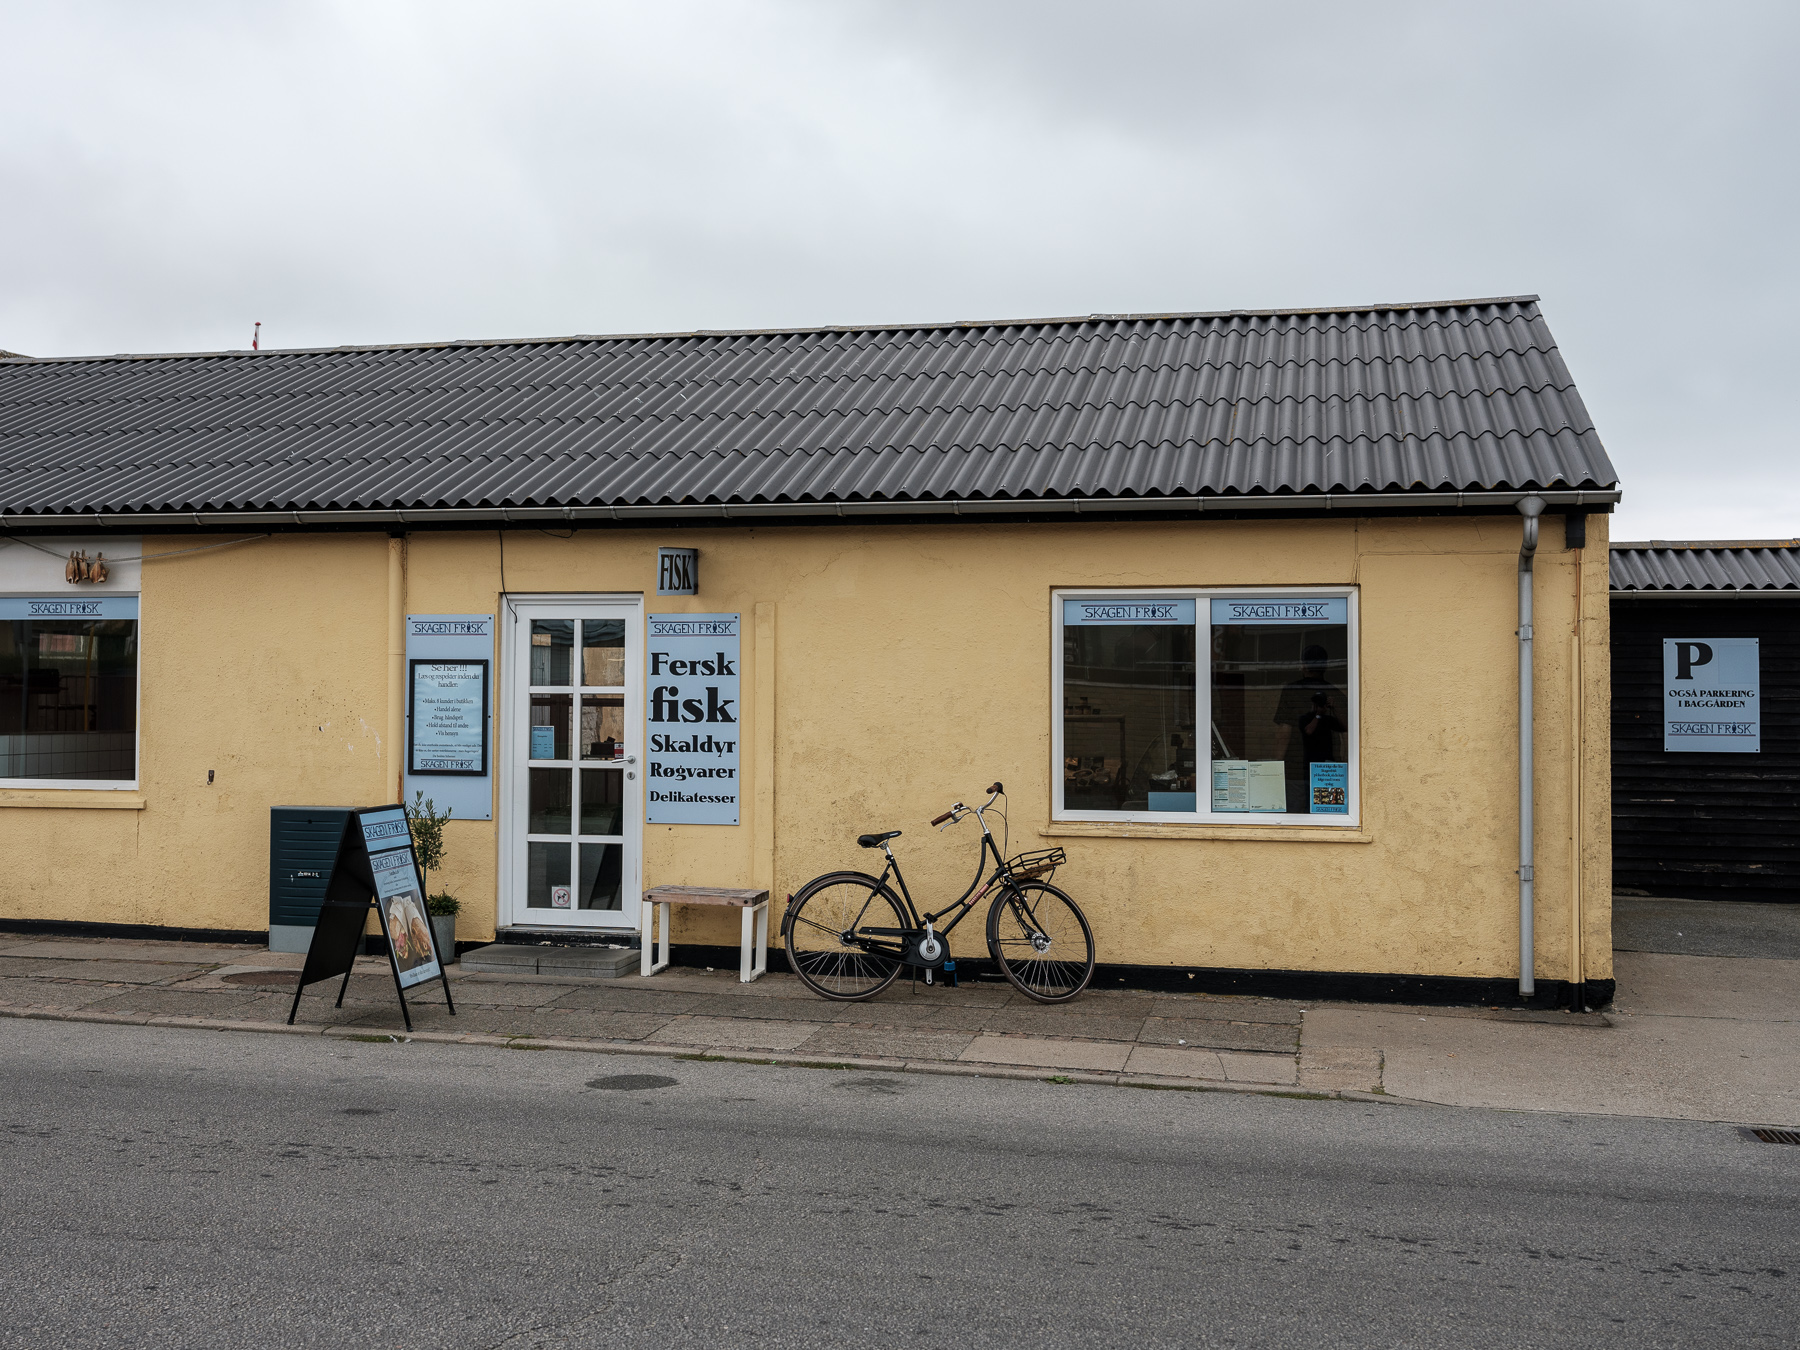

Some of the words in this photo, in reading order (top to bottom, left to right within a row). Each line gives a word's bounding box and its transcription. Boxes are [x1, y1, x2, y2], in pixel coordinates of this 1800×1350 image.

[659, 554, 692, 591] FISK
[31, 603, 67, 613] SKAGEN
[1085, 606, 1131, 618] SKAGEN
[1233, 605, 1279, 618] SKAGEN
[414, 623, 451, 633] SKAGEN
[654, 623, 695, 634] SKAGEN
[650, 652, 737, 676] Fersk
[1675, 642, 1713, 680] P
[1669, 689, 1698, 698] OGSÅ
[1700, 690, 1756, 698] PARKERING
[650, 686, 737, 723] fisk
[1678, 700, 1682, 708] I
[1684, 699, 1745, 708] BAGGÅRDEN
[1671, 723, 1714, 733] SKAGEN
[650, 734, 737, 758] Skaldyr
[420, 760, 449, 769] SKAGEN
[650, 762, 736, 781] Røgvarer
[649, 790, 736, 804] Delikatesser
[364, 823, 388, 838] SKAGEN
[372, 856, 393, 871] SKAGEN
